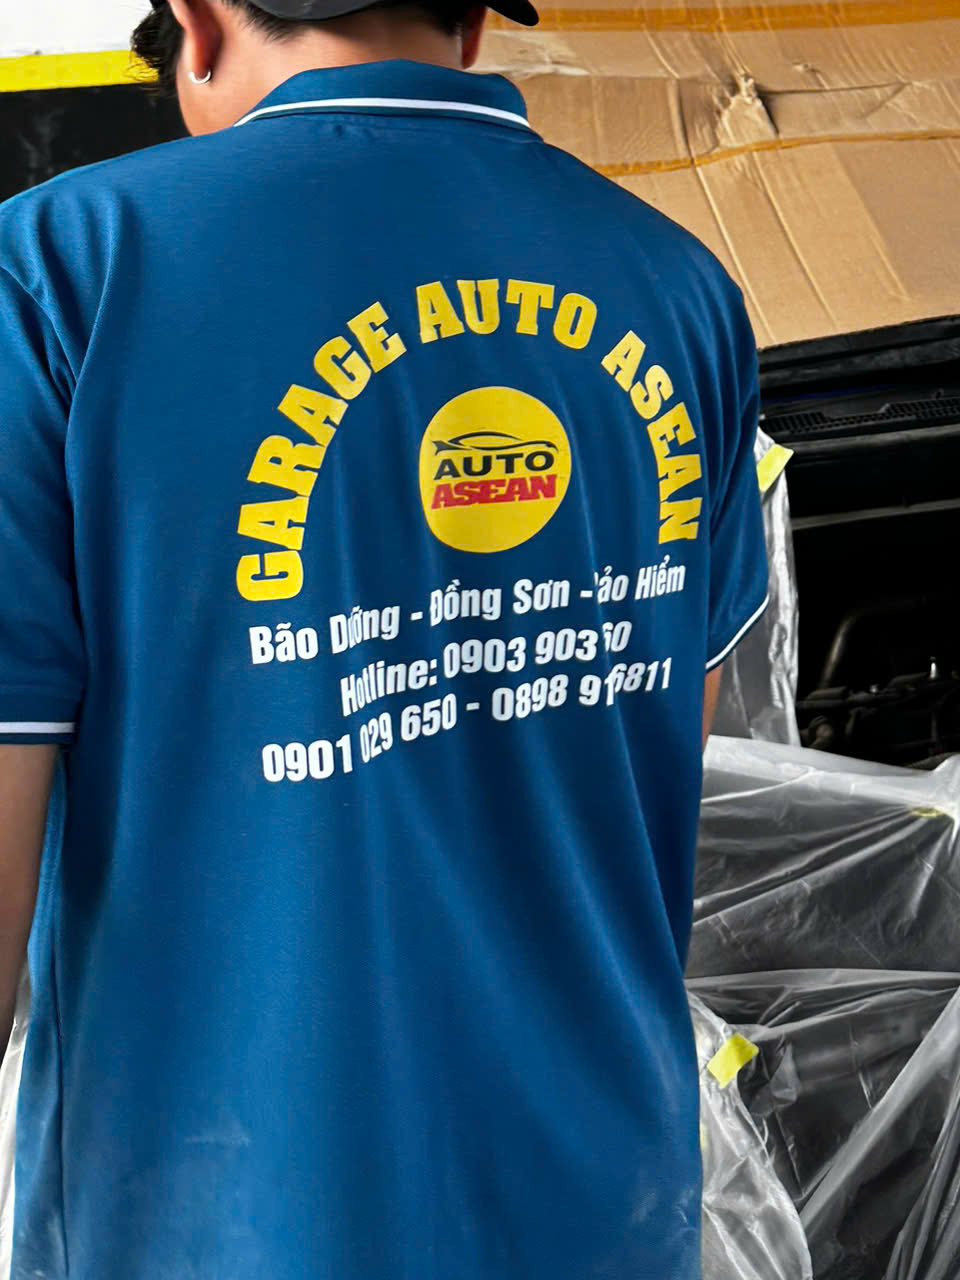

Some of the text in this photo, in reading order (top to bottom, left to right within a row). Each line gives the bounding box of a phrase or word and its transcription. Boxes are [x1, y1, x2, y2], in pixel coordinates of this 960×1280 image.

[236, 278, 702, 601] GARAGE AUTO ASEAN
[434, 451, 555, 480] AUTO
[431, 474, 558, 510] ASEAN
[249, 622, 319, 665] Bão
[512, 578, 570, 614] Sơn
[634, 554, 686, 600] Hiểm
[340, 659, 438, 717] Hotline:
[443, 636, 526, 679] 0903
[262, 733, 352, 783] 0901
[359, 711, 393, 764] 029
[401, 693, 457, 742] 650
[492, 674, 569, 721] 0898
